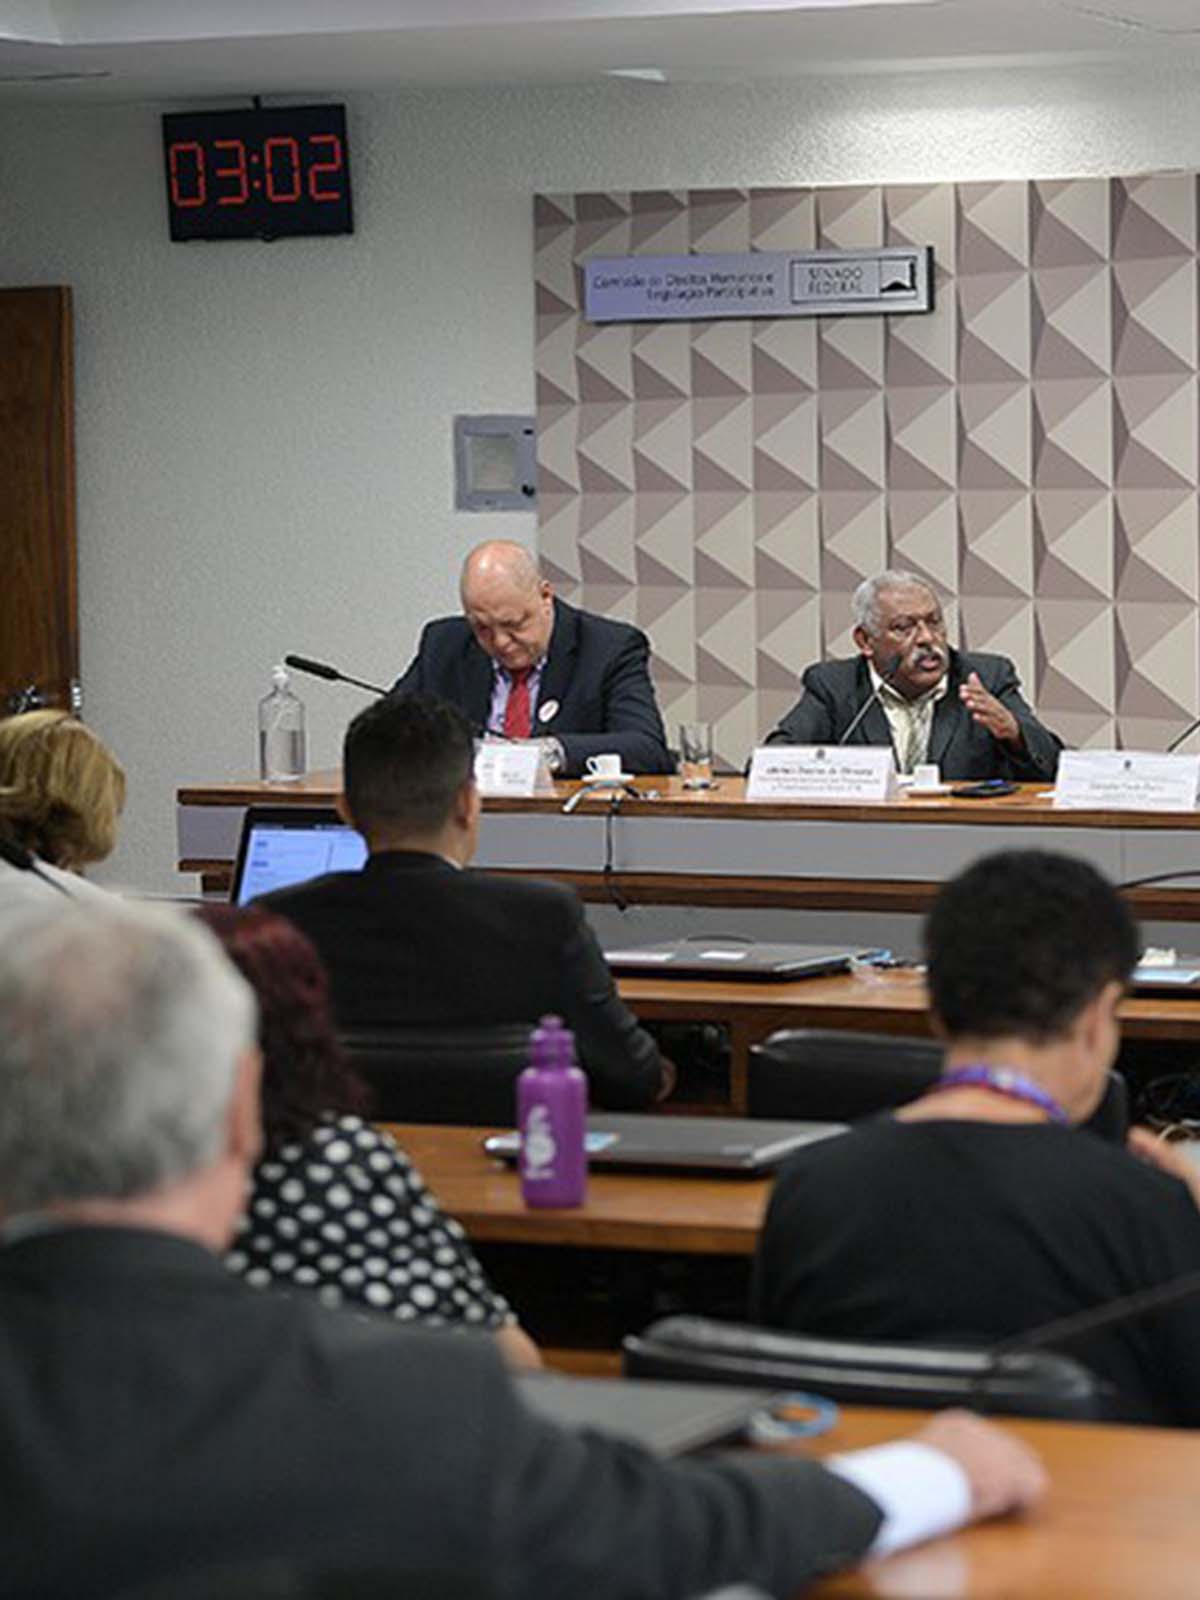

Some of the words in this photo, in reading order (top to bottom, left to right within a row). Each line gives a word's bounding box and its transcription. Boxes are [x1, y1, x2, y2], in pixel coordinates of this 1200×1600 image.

[169, 134, 343, 207] 03:02
[808, 266, 863, 281] SENADO
[808, 281, 863, 295] FEDERAL
